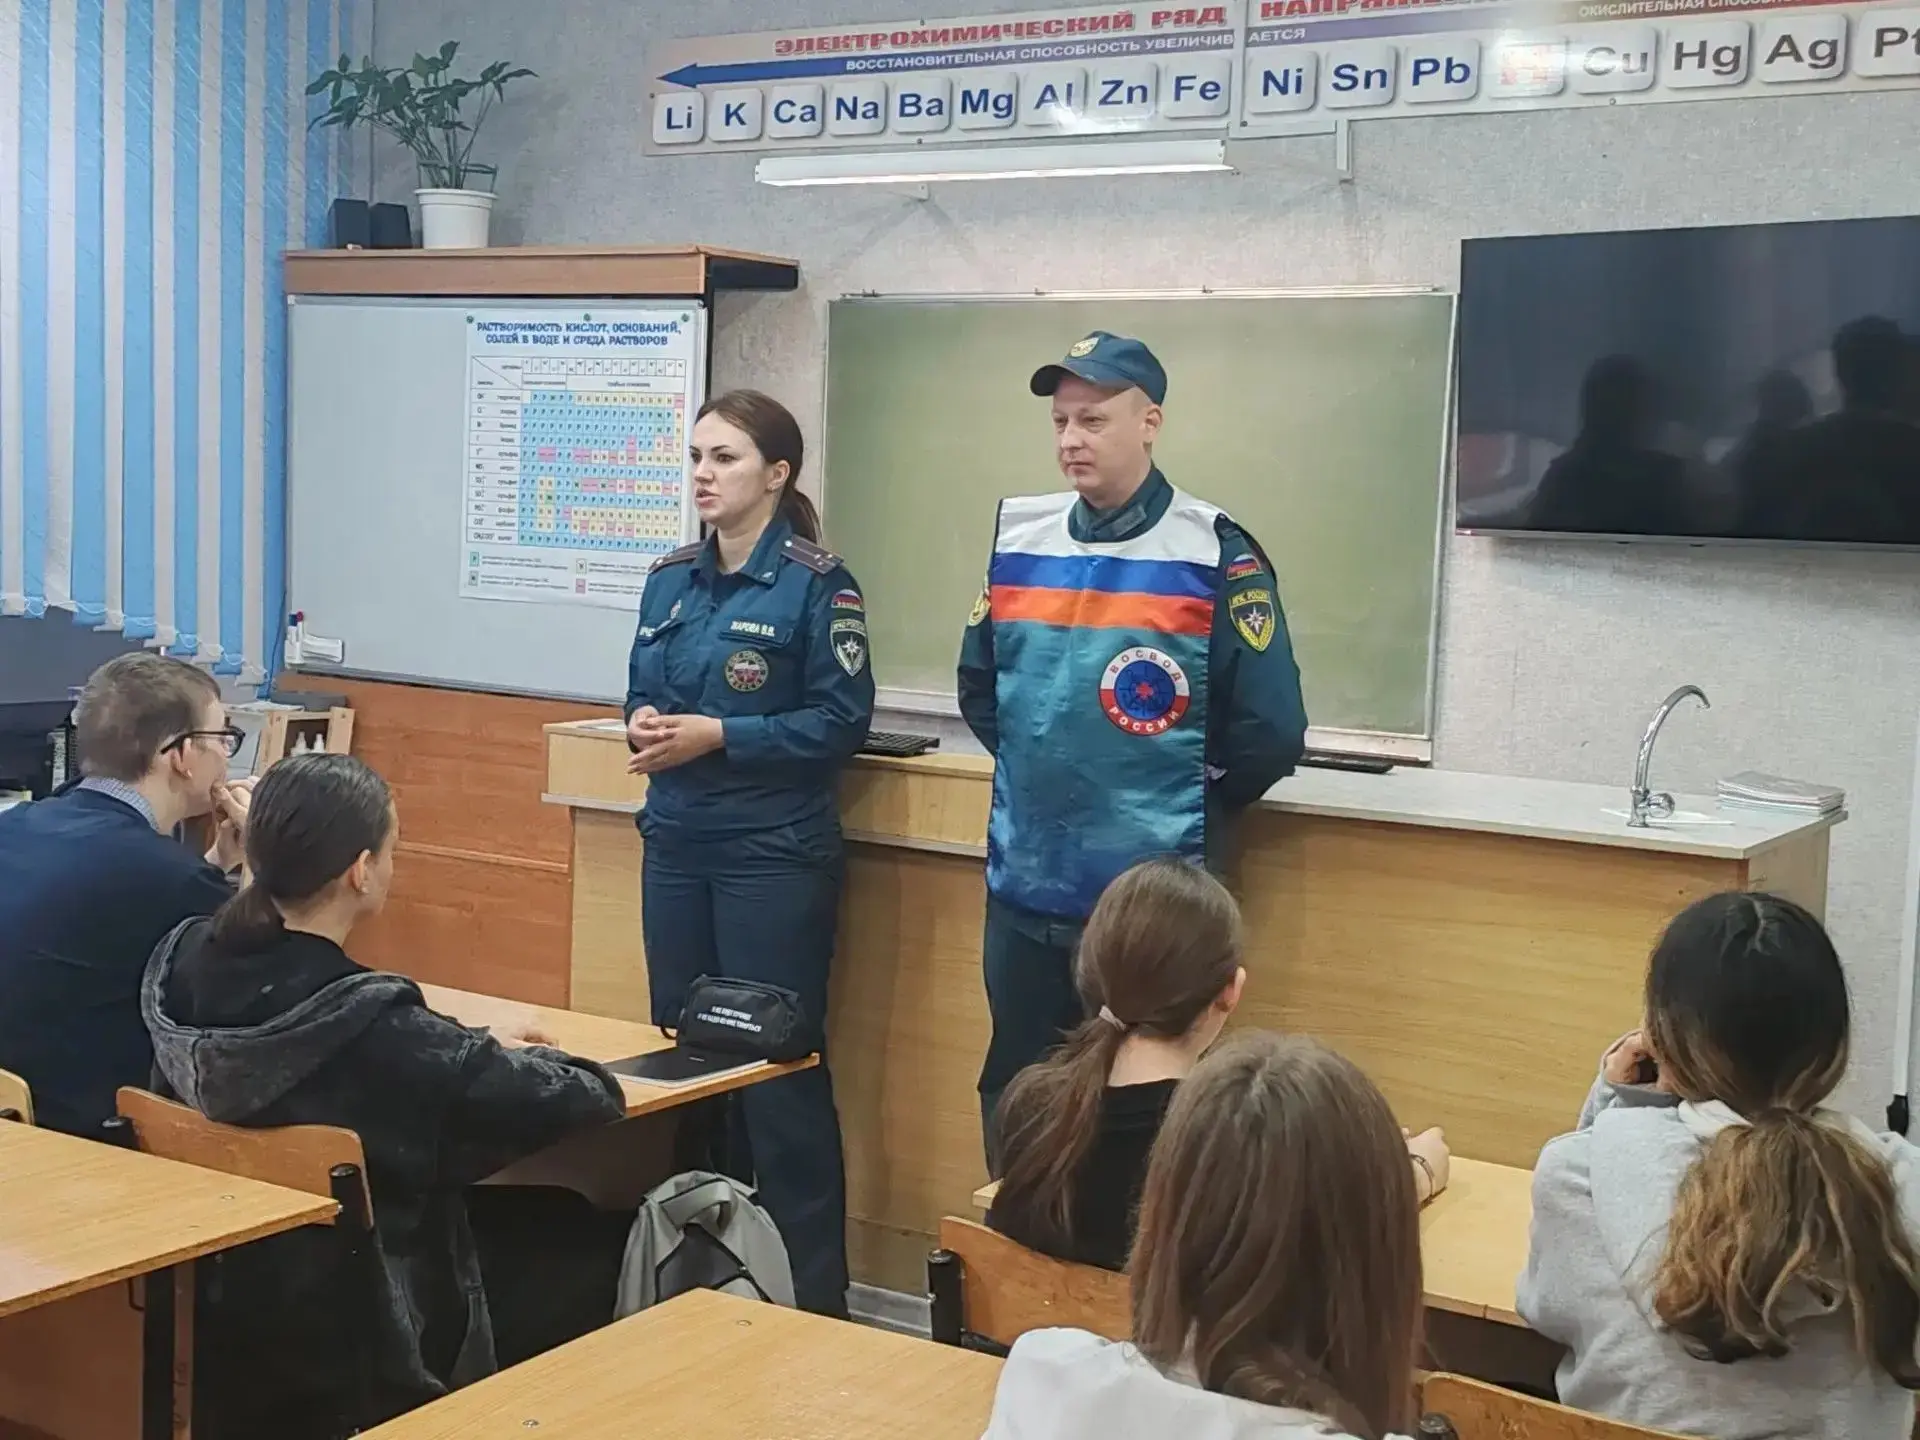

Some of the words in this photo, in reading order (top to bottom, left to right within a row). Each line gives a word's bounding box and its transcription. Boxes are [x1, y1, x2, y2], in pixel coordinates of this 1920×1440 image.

[775, 11, 1136, 56] ЭЛЕКТРОХИМИЧЕСКИЙ
[1151, 7, 1227, 28] РЯД
[846, 49, 1016, 71] ВОССТАНОВИТЕЛЬНАЯ
[1020, 42, 1141, 60] СПОСОБНОСТЬ
[1145, 34, 1234, 50] УВЕЛИЧИВ
[1248, 28, 1306, 43] АЕТСЯ
[666, 106, 692, 130] Li
[724, 102, 747, 126] K
[773, 99, 816, 123] Ca
[836, 96, 879, 121] Na
[900, 93, 944, 118] Ba
[961, 88, 1013, 118] Mg
[1033, 82, 1073, 110] Al
[1099, 79, 1148, 106] Zn
[1174, 75, 1221, 102] Fe
[1262, 68, 1302, 97] Ni
[1331, 63, 1388, 92] Sn
[1412, 57, 1471, 87] Pb
[1583, 46, 1648, 76] Cu
[1674, 40, 1742, 76] Hg
[1764, 34, 1839, 70] Ag
[477, 322, 562, 332] РАСТВОРИМОСТЬ
[566, 323, 610, 334] КИСЛОТ,
[612, 321, 682, 335] ОСНОВАНИЙ,
[486, 332, 519, 344] СОЛЕЙ
[522, 335, 529, 344] В
[532, 334, 560, 346] ВОДЕ
[562, 335, 570, 345] И
[573, 335, 606, 346] СРЕДА
[608, 335, 668, 346] РАСТВОРОВ
[1109, 649, 1182, 682] ВОСВОД
[1108, 706, 1179, 732] РОССИИ
